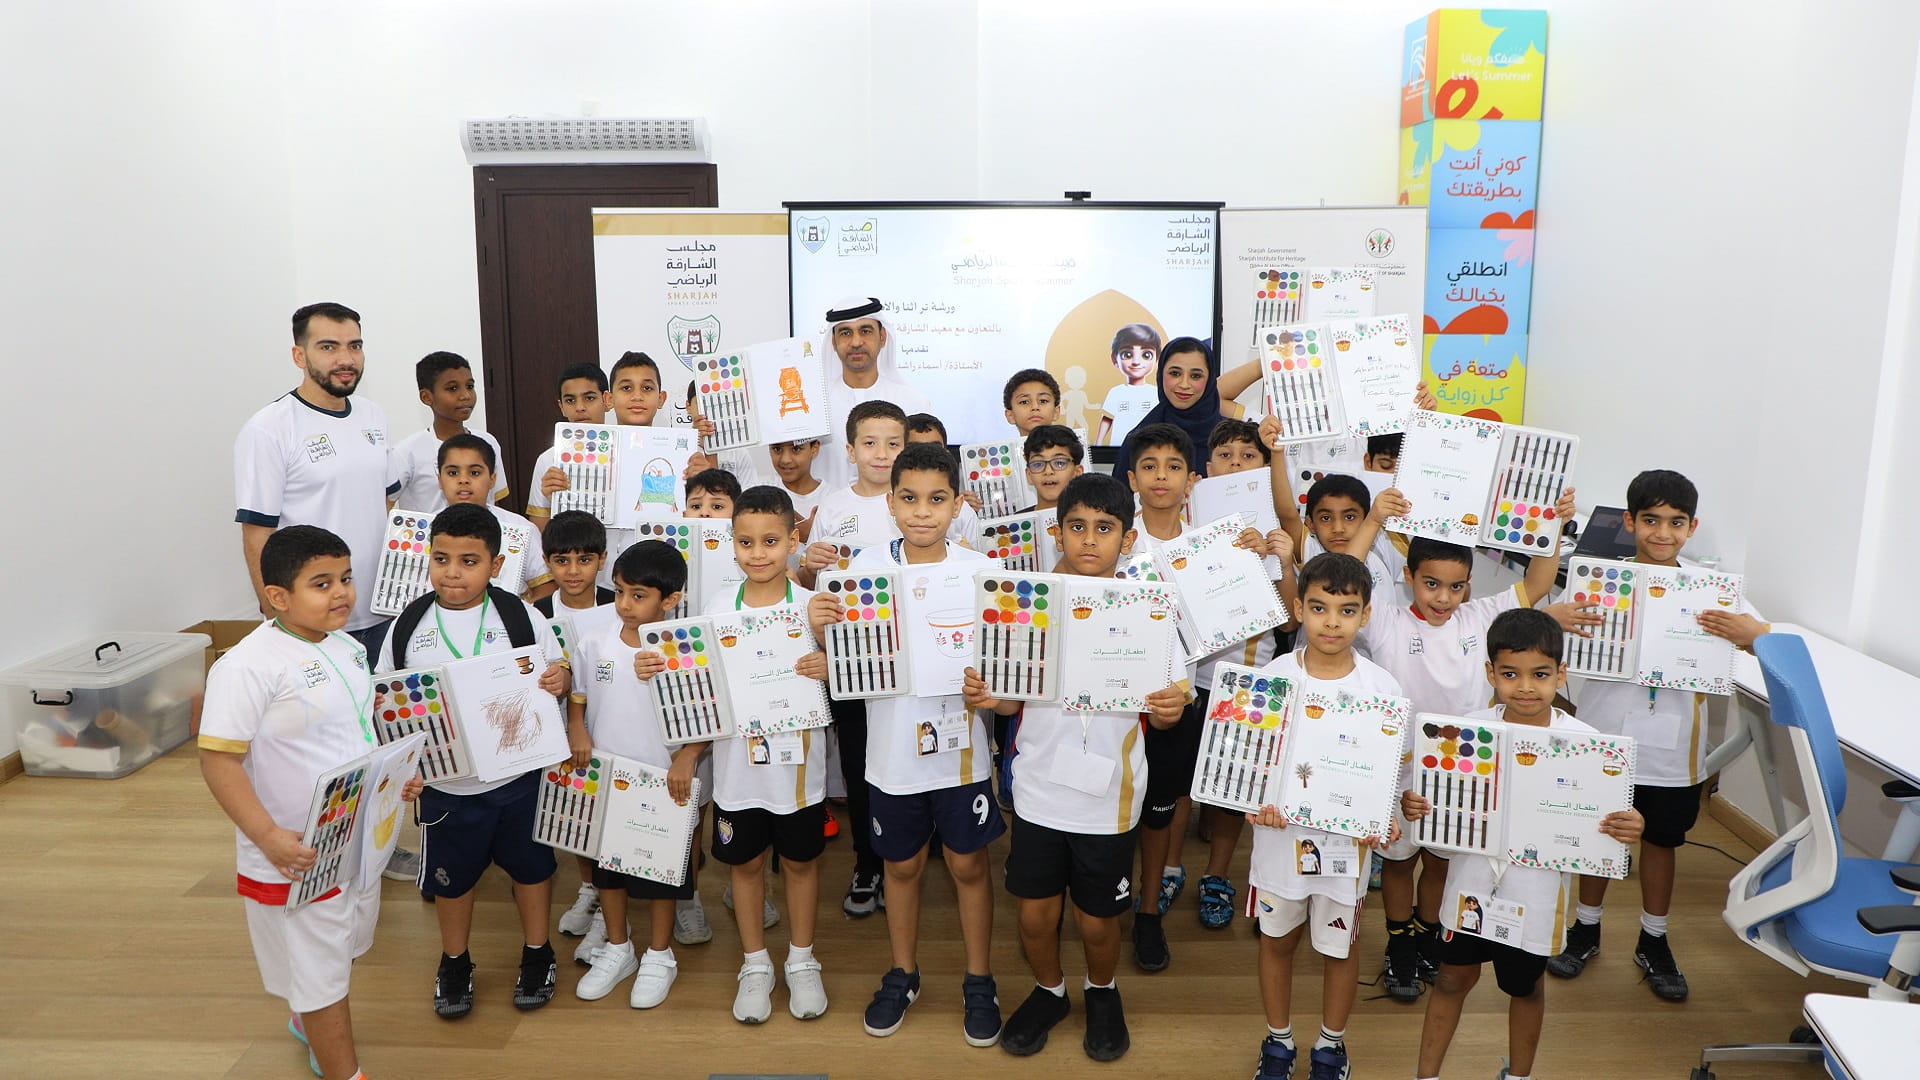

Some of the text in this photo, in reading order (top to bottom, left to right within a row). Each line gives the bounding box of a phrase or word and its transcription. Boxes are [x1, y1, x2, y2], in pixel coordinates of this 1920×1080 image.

[1451, 70, 1532, 81] Let's Summer
[1485, 156, 1527, 181] كوني
[1168, 213, 1211, 226] مجلس
[842, 233, 873, 242] الشارقة
[1167, 228, 1210, 240] الشارقة
[666, 240, 716, 254] مجلس
[844, 242, 875, 254] الرياضي
[1167, 242, 1210, 255] الرياضي
[666, 257, 716, 272] الشارقة
[1166, 258, 1210, 266] SHARJAH
[1285, 255, 1306, 263] Heritage
[1447, 262, 1507, 286] انطلقي
[667, 273, 717, 288] الرياضي
[953, 276, 993, 287] Sharjah
[667, 292, 718, 300] SHARJAH
[1445, 287, 1505, 307] بخيالك
[932, 301, 956, 314] ورشة
[896, 322, 929, 333] الشارقة
[954, 326, 965, 336] مع
[967, 323, 1002, 334] بالتعاون
[901, 344, 929, 354] تقدمها
[1438, 360, 1508, 386] متعة في
[1437, 386, 1510, 405] كل زواية
[972, 793, 990, 826] 9
